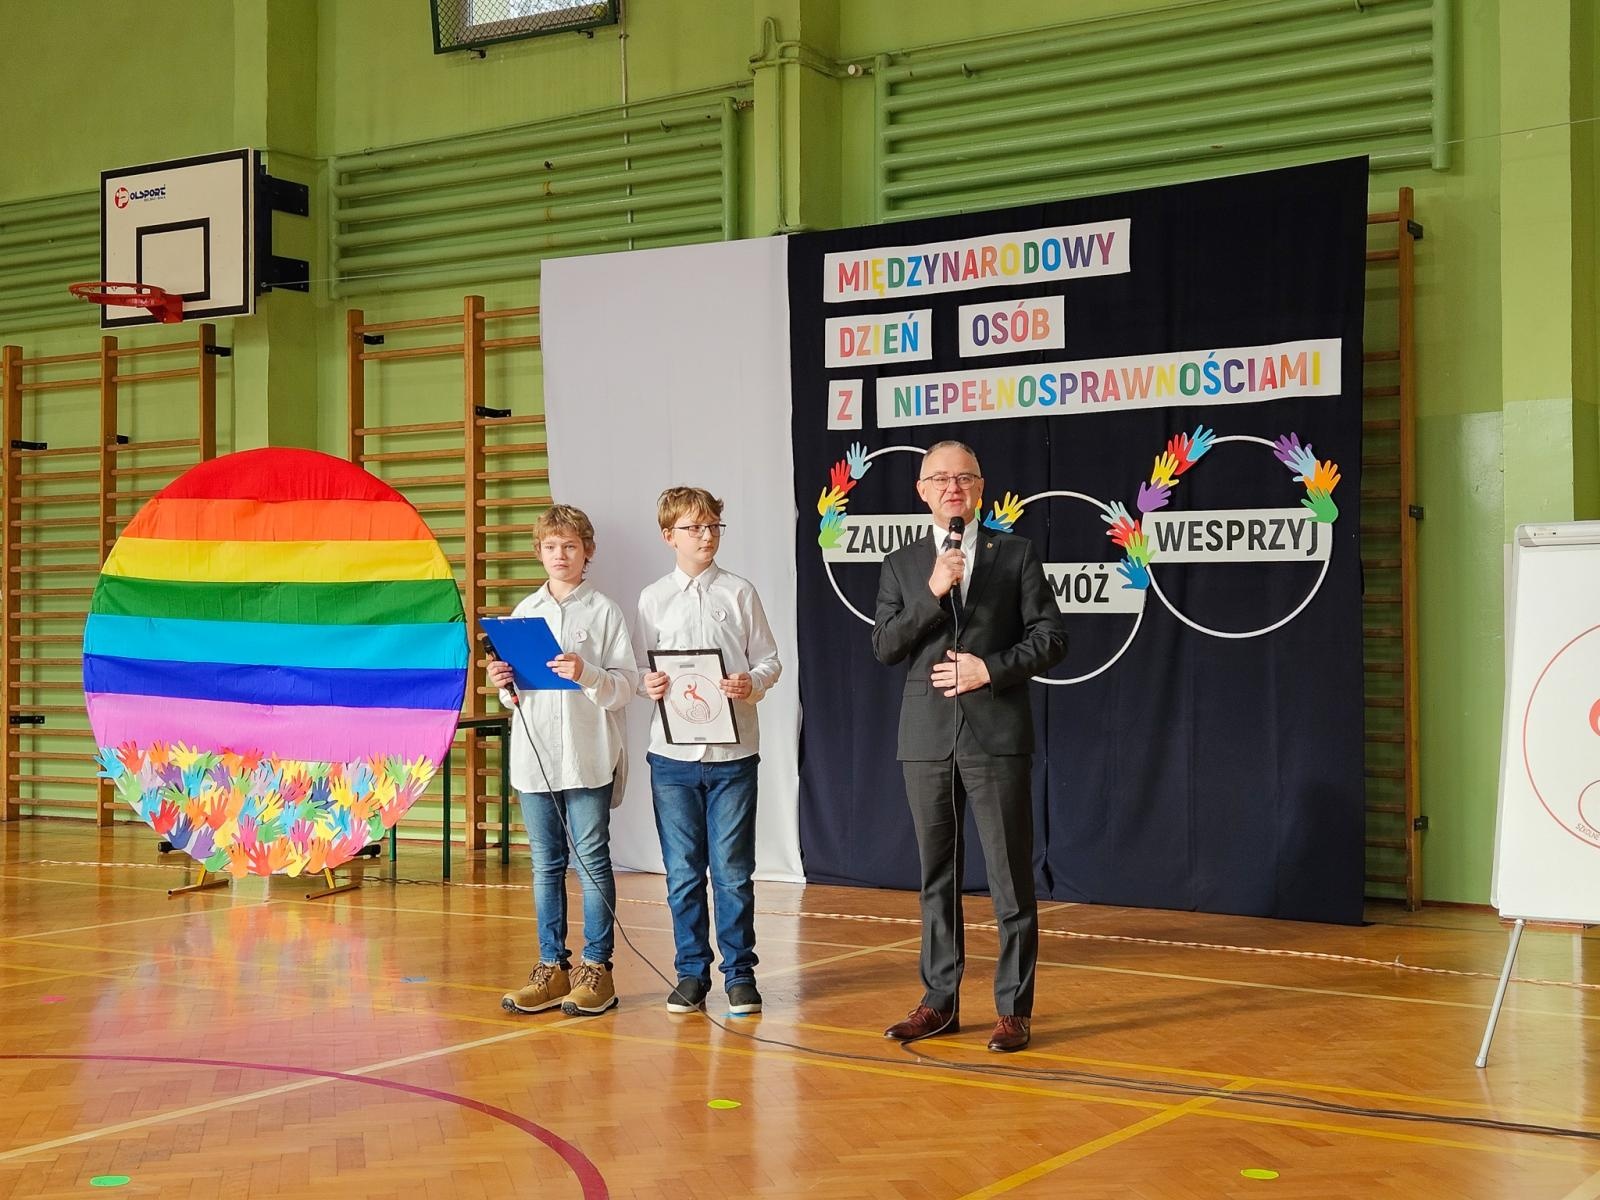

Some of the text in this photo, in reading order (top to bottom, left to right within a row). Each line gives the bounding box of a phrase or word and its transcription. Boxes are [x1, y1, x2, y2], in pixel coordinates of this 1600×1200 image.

[838, 231, 1115, 296] MIĘDZYNARODOWY
[839, 302, 1050, 358] DZIEŃ OSÓB
[838, 352, 1321, 421] Z NIEPEŁNOSPRAWNOŚCIAMI
[1155, 518, 1317, 556] WESPRZYJ
